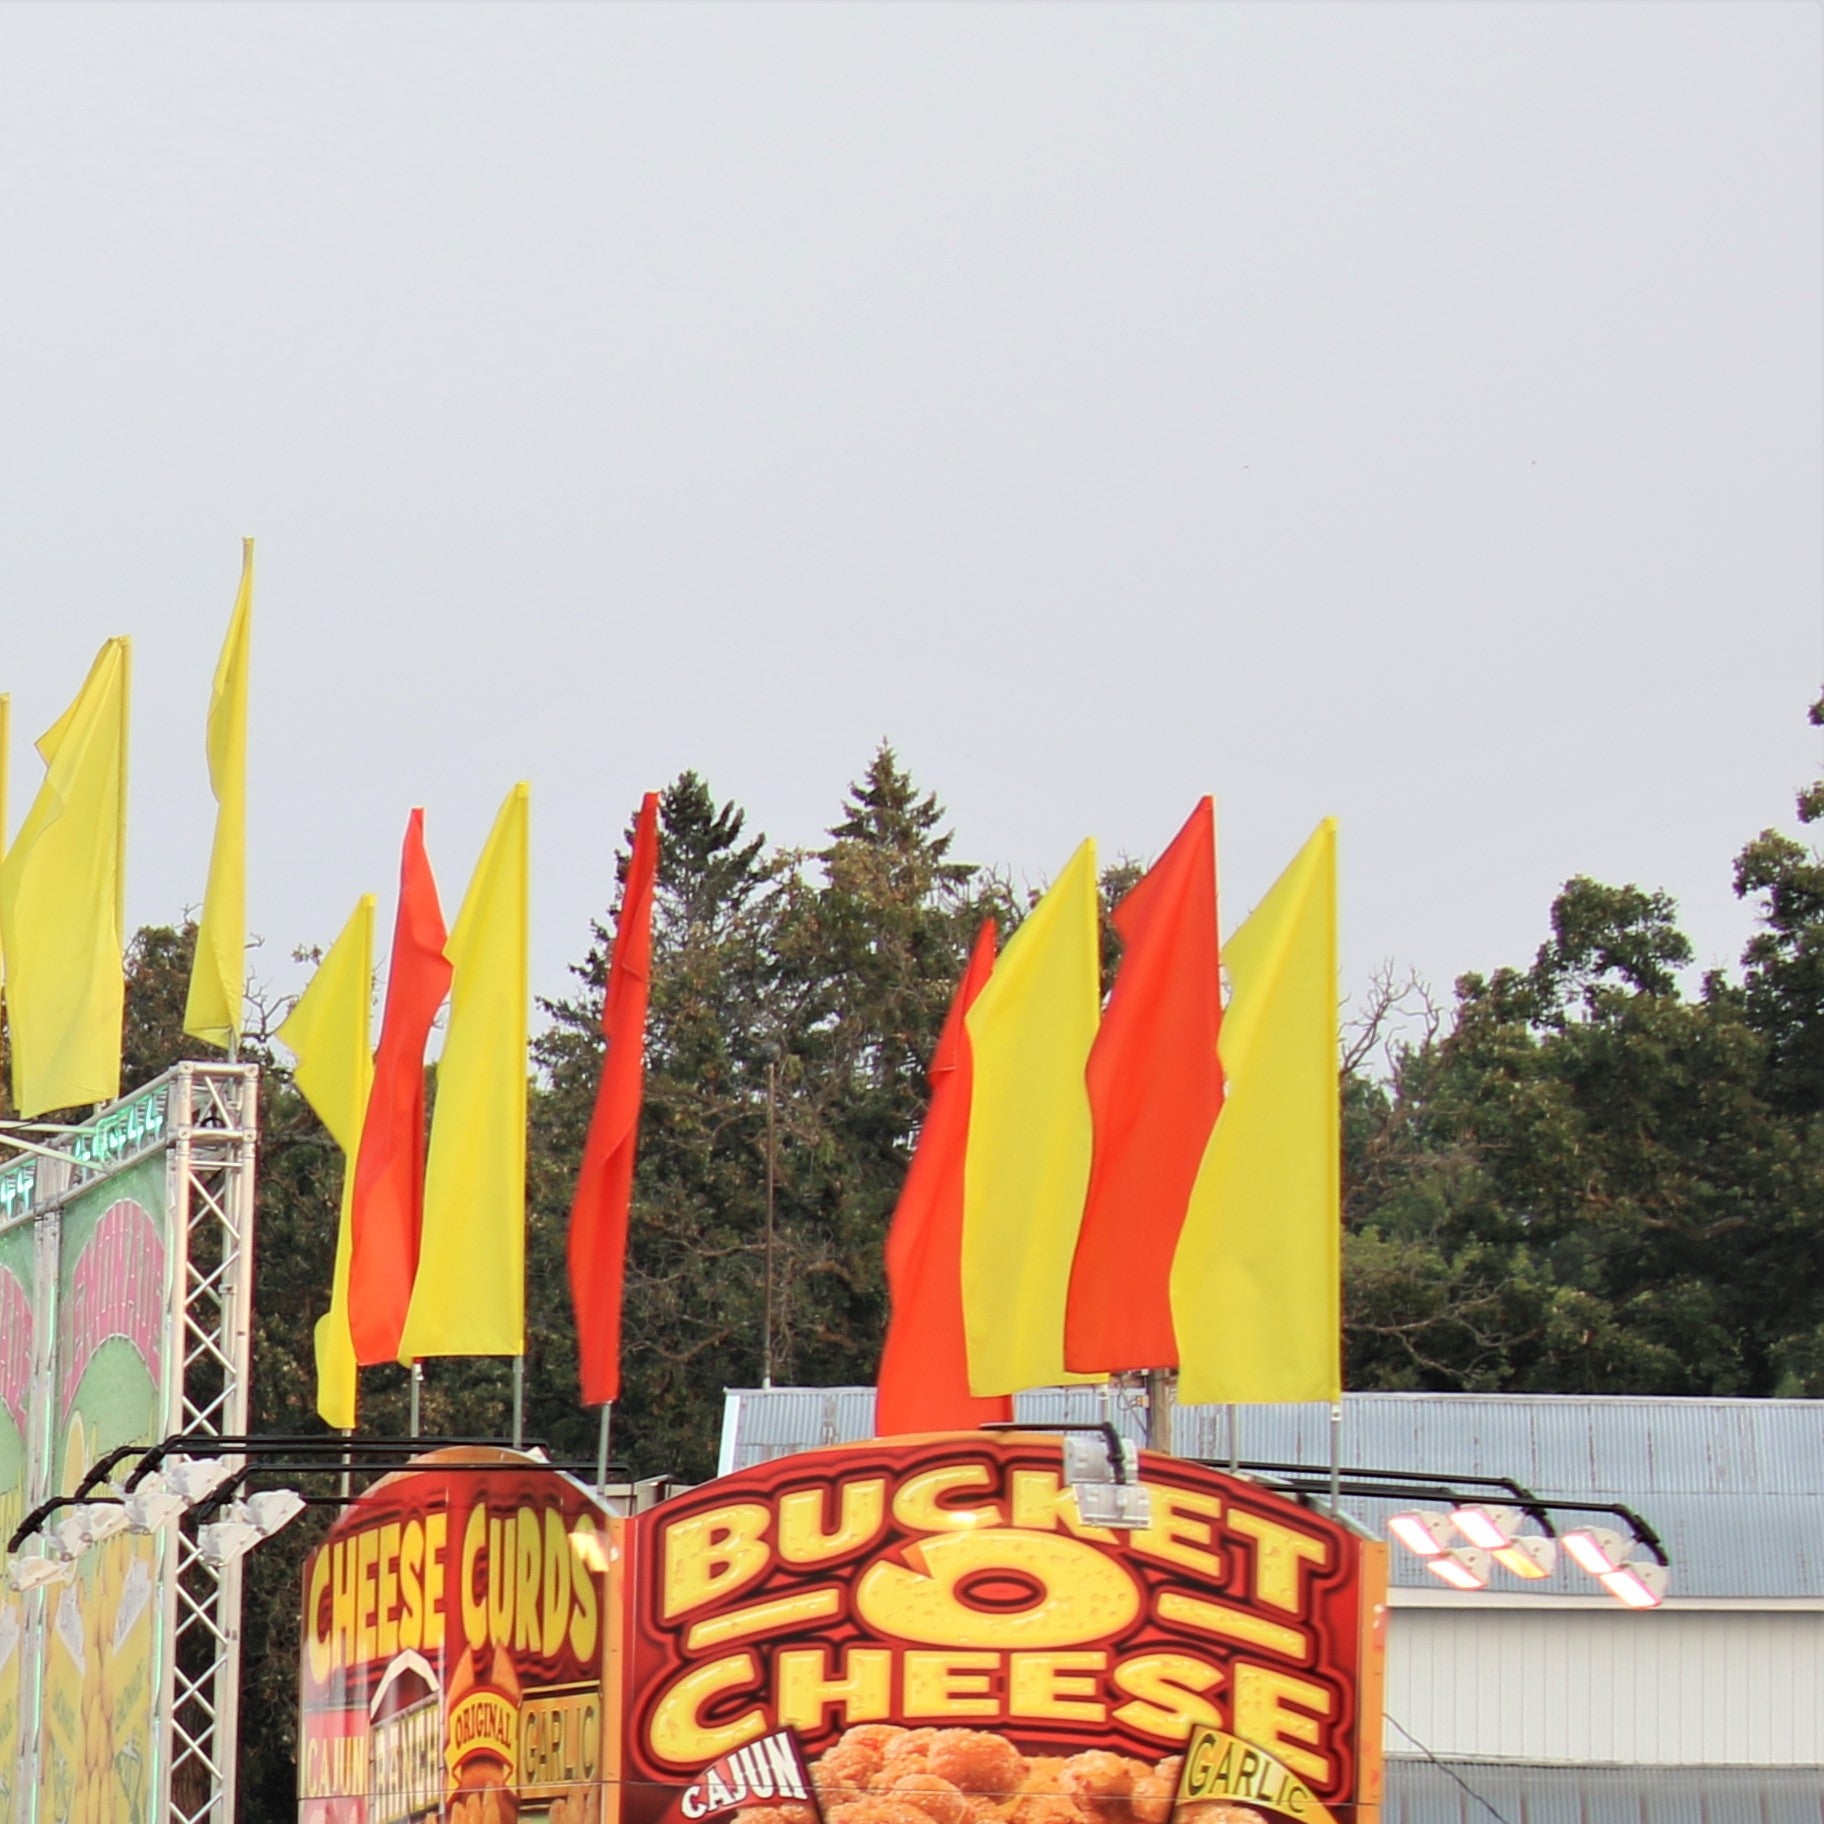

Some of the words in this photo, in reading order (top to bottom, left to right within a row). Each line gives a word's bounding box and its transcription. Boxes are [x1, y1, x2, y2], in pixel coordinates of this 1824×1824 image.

[663, 1463, 1328, 1621] BUCKET
[309, 1512, 448, 1686] CHEESE
[460, 1500, 599, 1664] CURDS
[452, 1698, 513, 1753] ORIGINAL
[523, 1703, 599, 1787] GARLIC
[649, 1648, 1330, 1785] CHEESE
[307, 1731, 367, 1800] CAJUN
[681, 1731, 805, 1820] CAJUN
[1187, 1732, 1310, 1815] GARLIC
